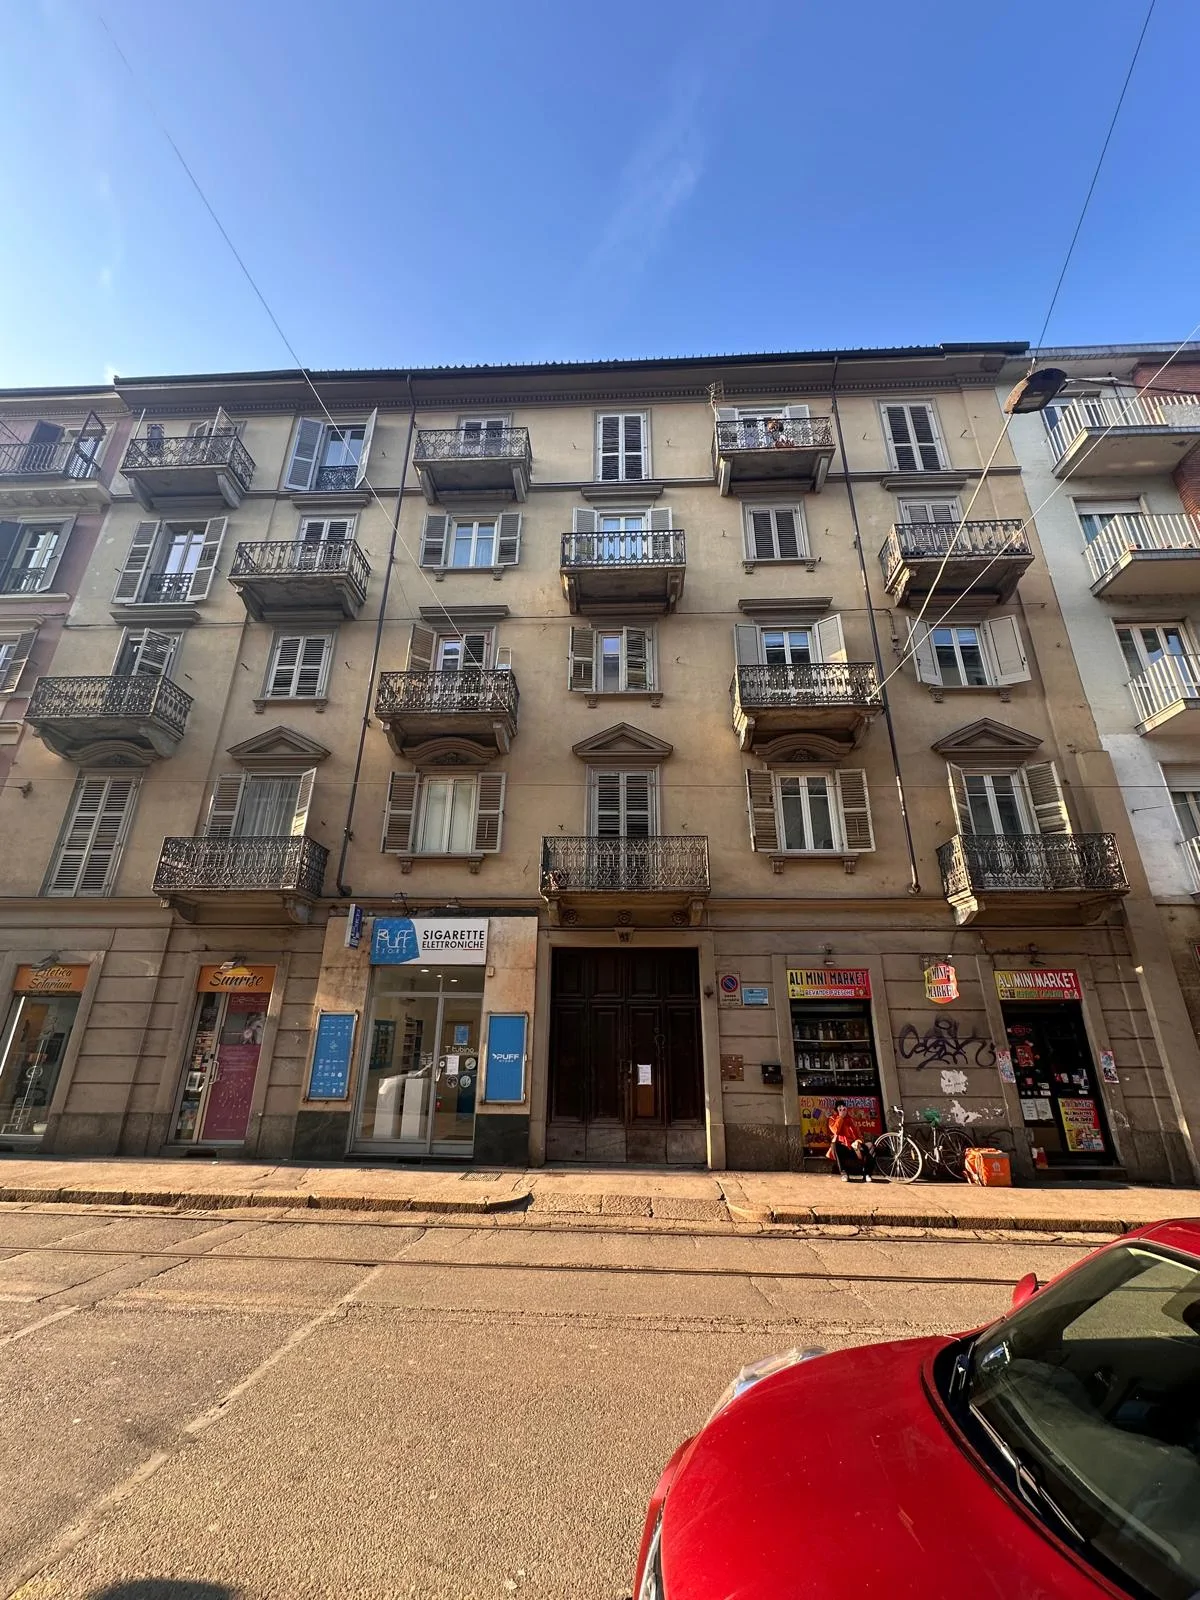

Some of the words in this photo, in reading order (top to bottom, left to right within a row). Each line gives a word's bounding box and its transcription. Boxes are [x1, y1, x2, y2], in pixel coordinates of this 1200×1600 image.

[423, 930, 484, 940] SIGARETTE
[422, 940, 484, 949] ELETTRONICHE
[28, 978, 72, 989] Solarium
[209, 971, 263, 987] Sunrise
[790, 972, 803, 985] ALI
[806, 972, 827, 984] MINI
[830, 972, 865, 985] MARKET
[999, 974, 1014, 987] ALI
[1013, 973, 1035, 987] MINI
[1035, 973, 1076, 987] MARKET
